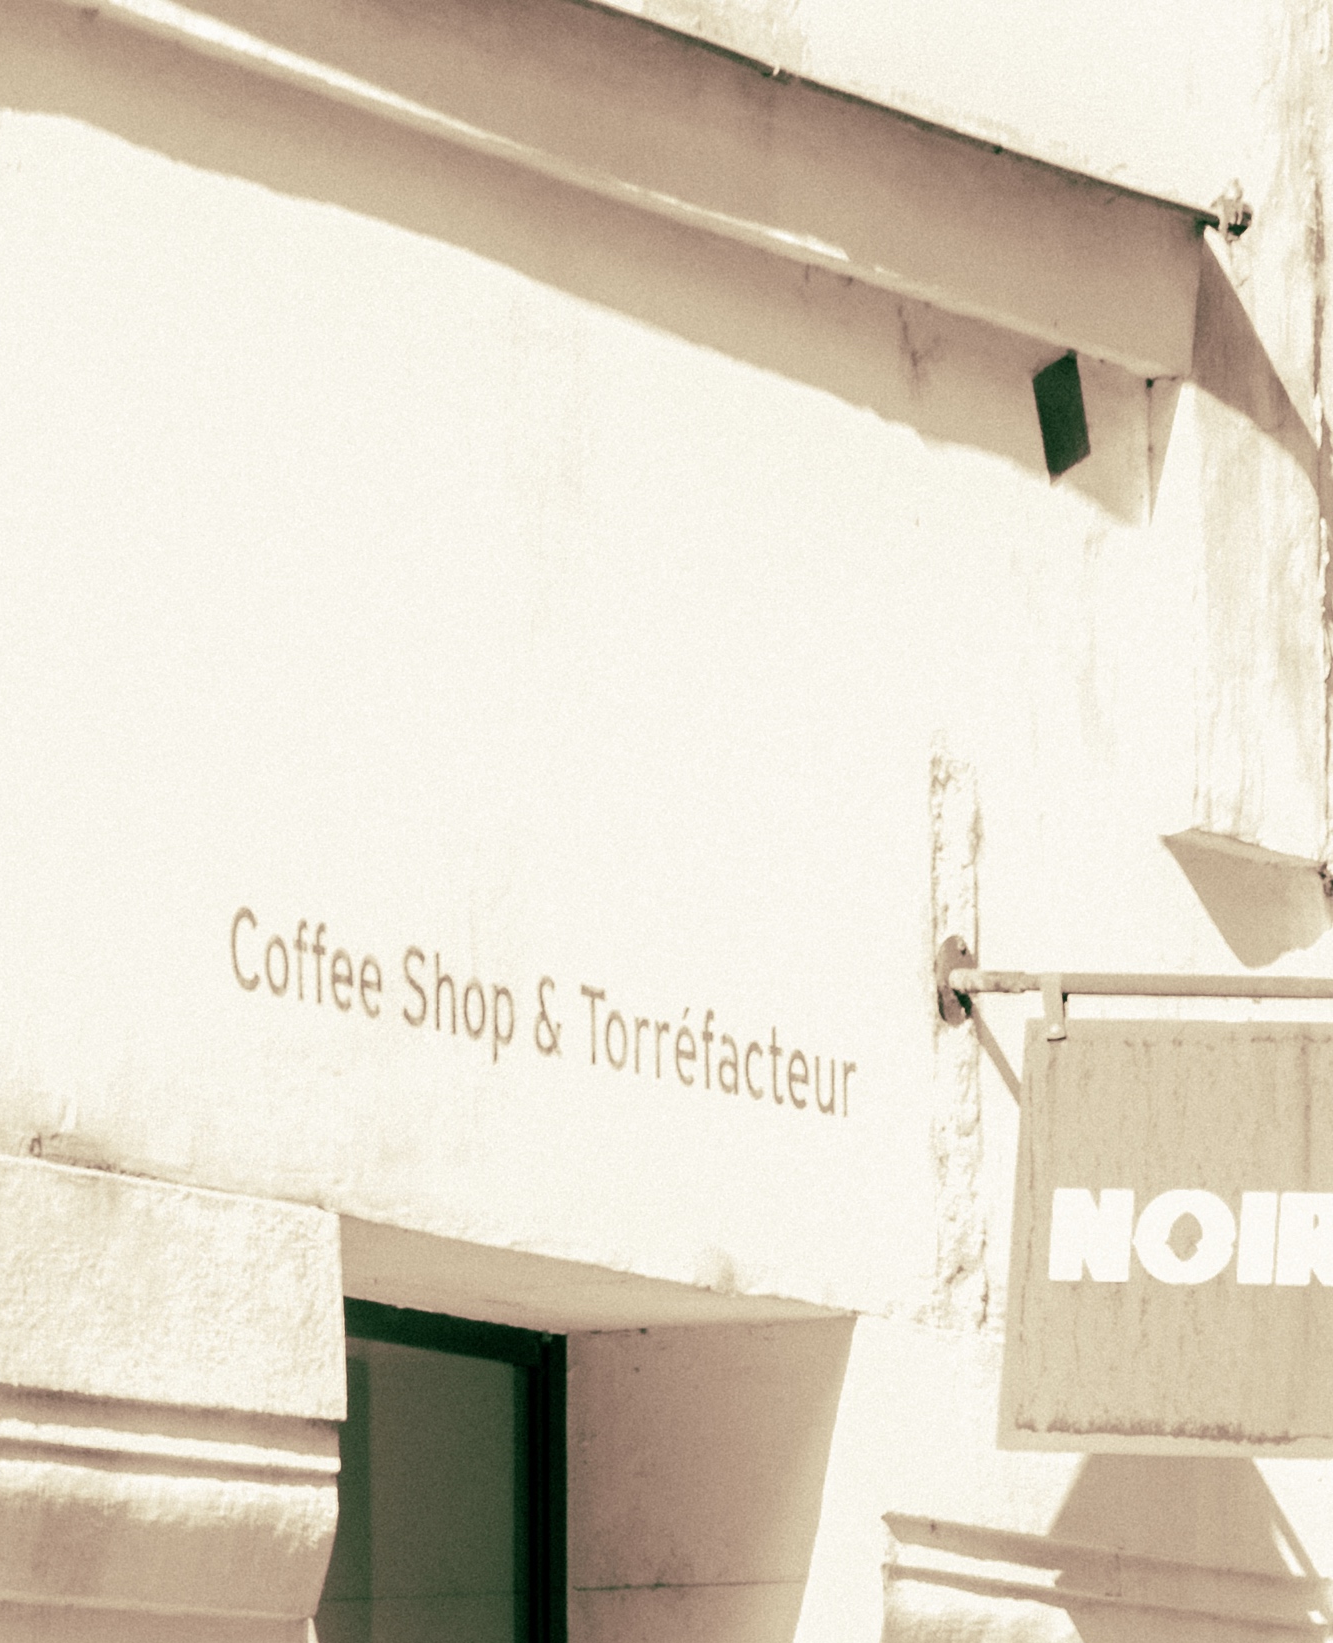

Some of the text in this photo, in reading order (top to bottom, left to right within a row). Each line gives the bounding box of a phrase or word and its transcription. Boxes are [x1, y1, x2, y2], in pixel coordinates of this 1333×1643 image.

[230, 906, 857, 1118] Coffee Shop & Torréfacteur
[1048, 1187, 1333, 1286] NOIR
